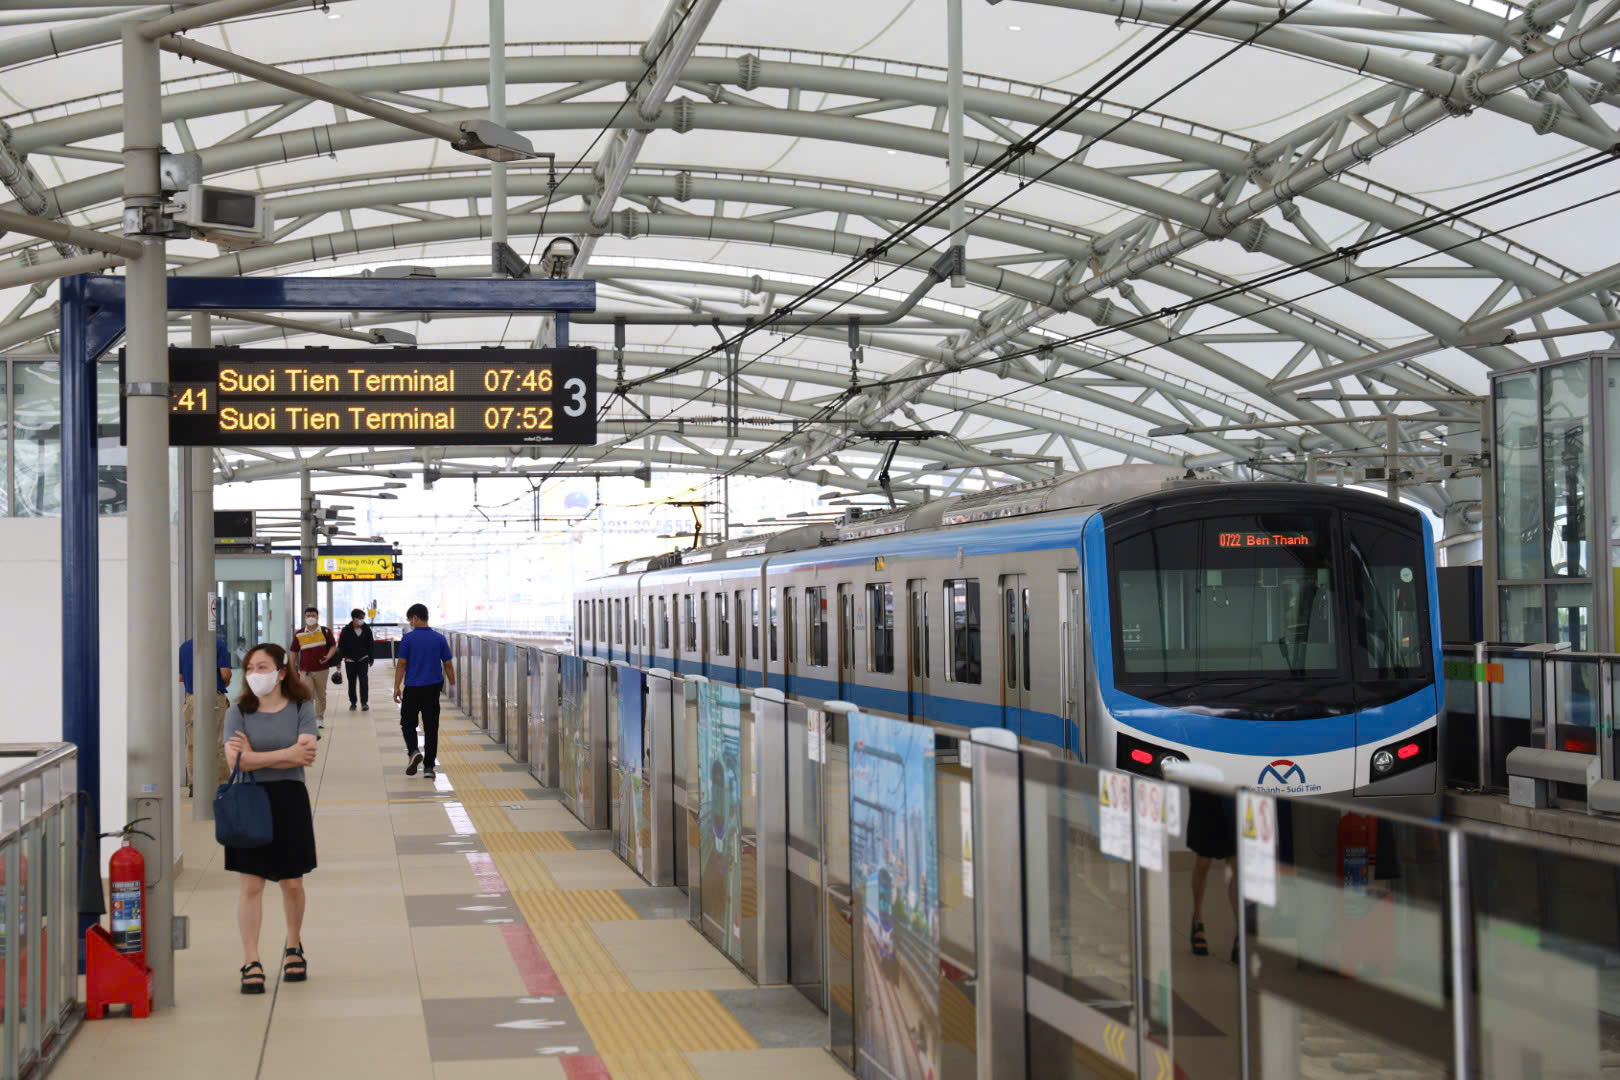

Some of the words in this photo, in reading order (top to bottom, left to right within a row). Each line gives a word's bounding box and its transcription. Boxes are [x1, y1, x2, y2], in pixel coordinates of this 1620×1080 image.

[219, 368, 275, 392] Suoi
[285, 368, 340, 392] Tien
[348, 368, 455, 392] Terminal
[483, 368, 553, 392] 07:46
[172, 387, 208, 411] :41
[563, 377, 587, 418] 3
[219, 407, 275, 431] Suoi
[285, 407, 340, 431] Tien
[348, 407, 455, 431] Terminal
[484, 407, 553, 430] 07:52
[1219, 533, 1242, 547] 0722
[1246, 534, 1270, 546] Ben
[1272, 534, 1309, 545] Thanh
